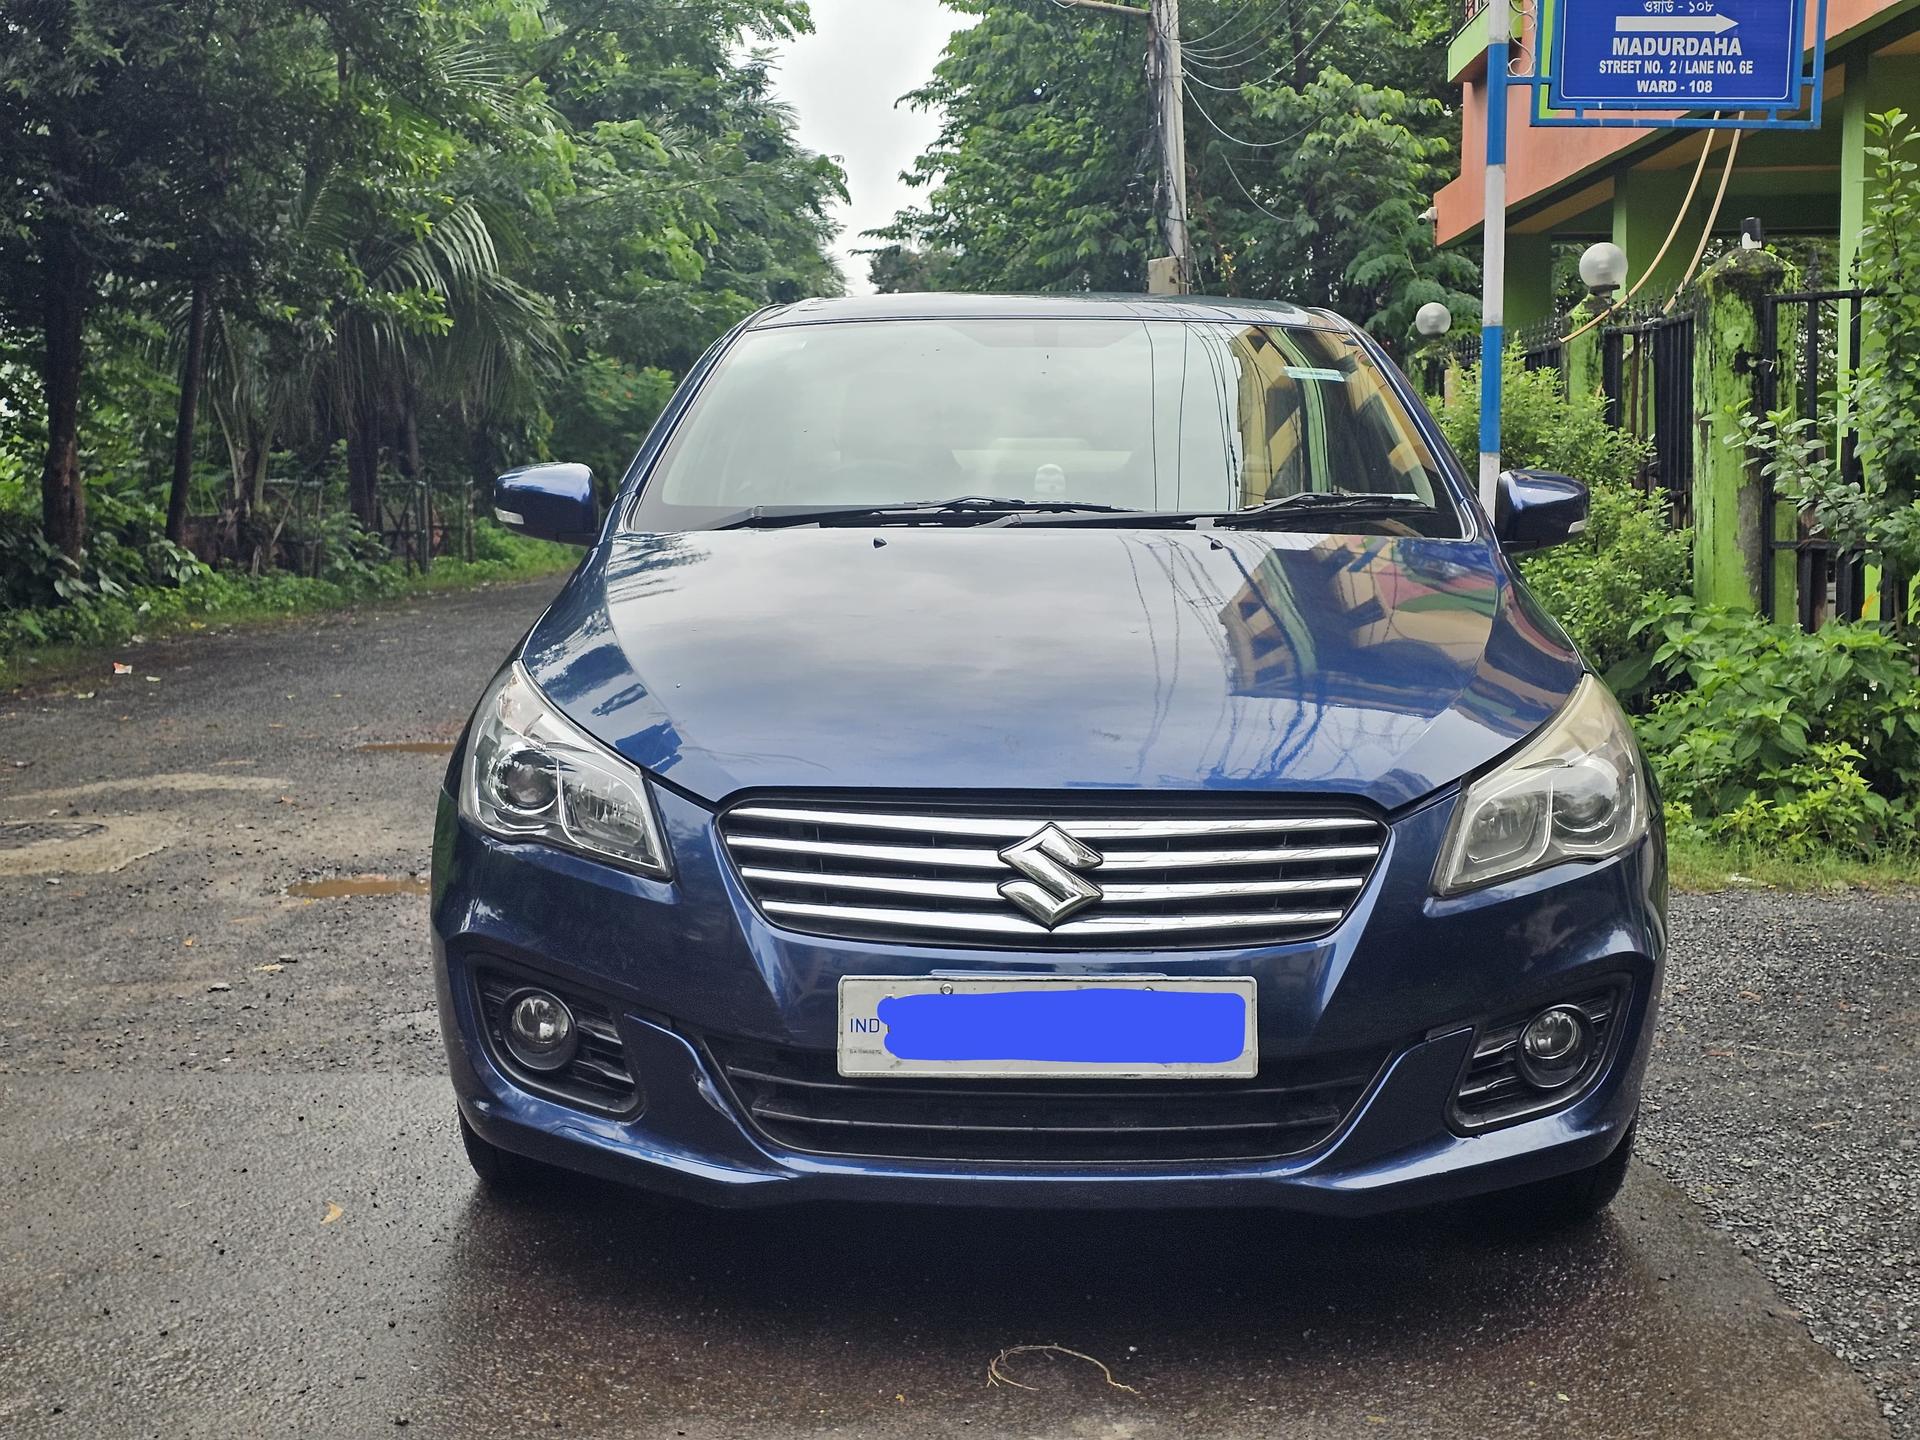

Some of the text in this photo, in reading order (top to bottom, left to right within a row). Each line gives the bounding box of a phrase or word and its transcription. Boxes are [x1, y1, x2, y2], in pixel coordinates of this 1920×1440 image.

[1688, 1, 1714, 14] ১০৮
[1612, 37, 1743, 56] MADURDAHA
[1599, 60, 1641, 75] STREET
[1644, 60, 1664, 75] NO.
[1669, 60, 1677, 75] 2
[1685, 60, 1714, 75] LANE
[1717, 60, 1737, 75] NO.
[1739, 60, 1753, 75] 6E
[1637, 80, 1677, 93] WARD
[1689, 80, 1713, 93] 108
[850, 1018, 880, 1033] IND
